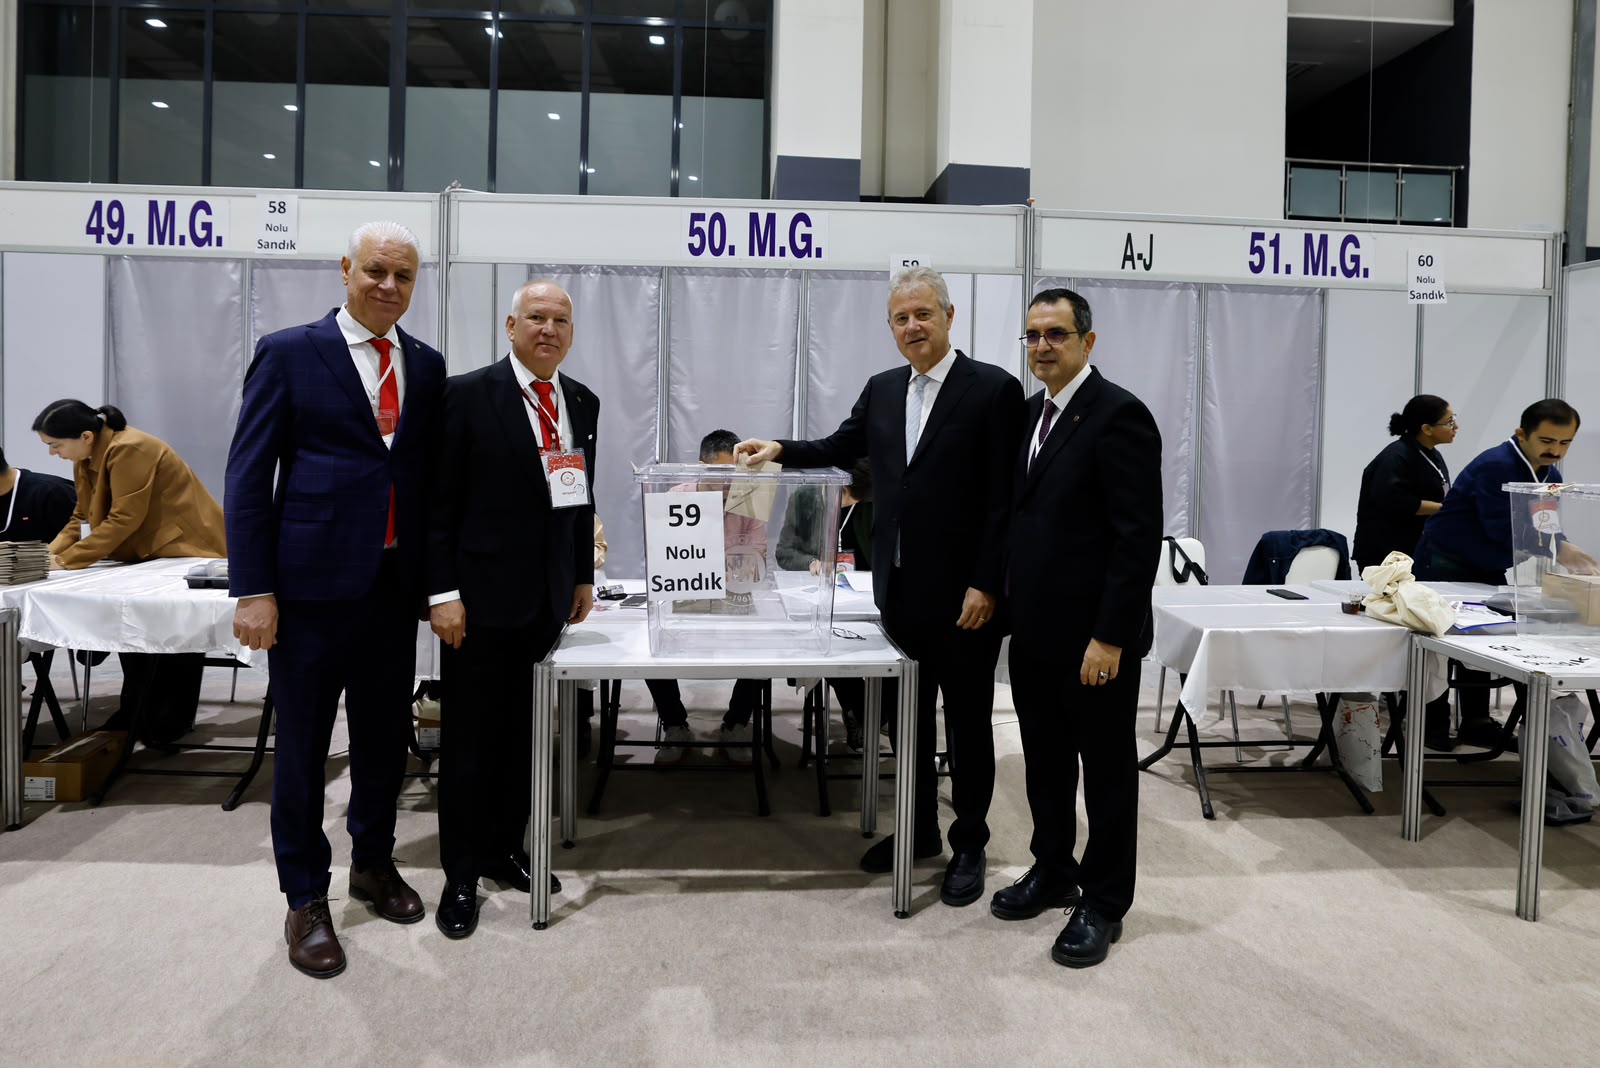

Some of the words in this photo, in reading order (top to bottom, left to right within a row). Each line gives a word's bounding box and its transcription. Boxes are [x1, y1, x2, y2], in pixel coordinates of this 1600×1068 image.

[268, 200, 287, 214] 58
[85, 199, 134, 246] 49.
[147, 199, 223, 248] M.G.
[265, 222, 288, 233] Nolu
[687, 211, 736, 257] 50.
[748, 211, 823, 259] M.G.
[257, 239, 297, 251] Sandık
[1120, 232, 1155, 272] A-J
[1248, 231, 1292, 275] 51.
[1303, 232, 1370, 279] M.G.
[1417, 254, 1434, 268] 60
[1416, 275, 1436, 284] Nolu
[1409, 289, 1446, 301] Sandık
[668, 503, 701, 527] 59
[665, 544, 706, 560] Nolu
[651, 571, 723, 593] Sandık
